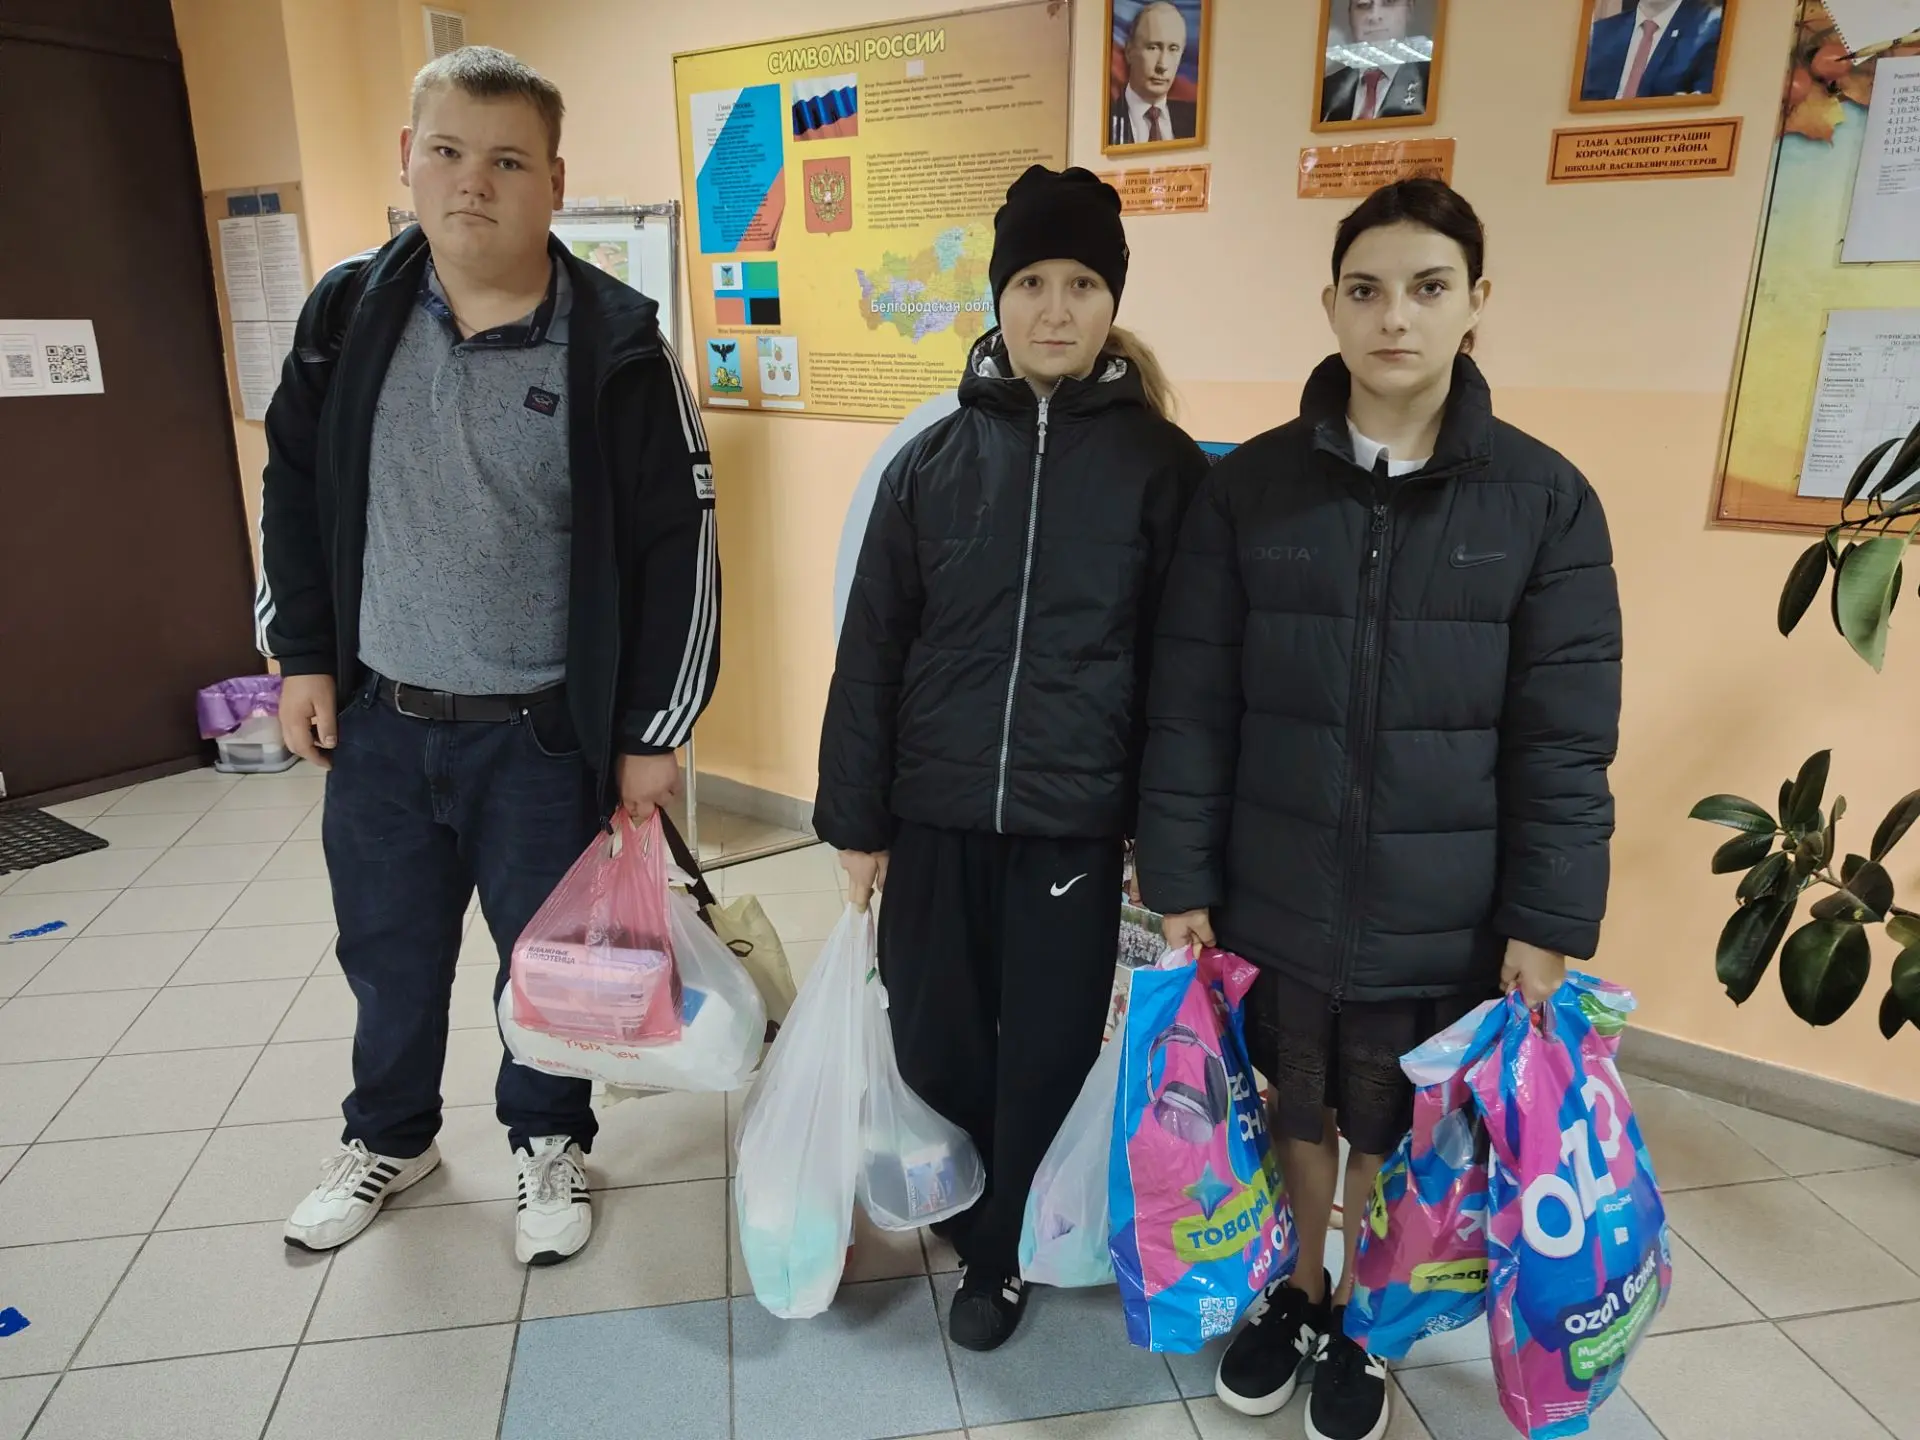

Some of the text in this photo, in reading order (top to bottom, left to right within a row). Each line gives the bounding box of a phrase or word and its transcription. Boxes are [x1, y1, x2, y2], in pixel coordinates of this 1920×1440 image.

[767, 28, 946, 75] СИМВОЛЫ РОССИИ
[1575, 131, 1711, 148] ГЛАВА АДМИНИСТРАЦИИ
[1575, 143, 1709, 159] КОРОЧАНСКОГО РАЙОНА
[1564, 157, 1718, 173] НИКОЛАЙ ВАСИЛЬЕВИЧ НЕСТЕРОВ
[870, 298, 995, 315] Белгородская обла
[1622, 1250, 1658, 1304] банк
